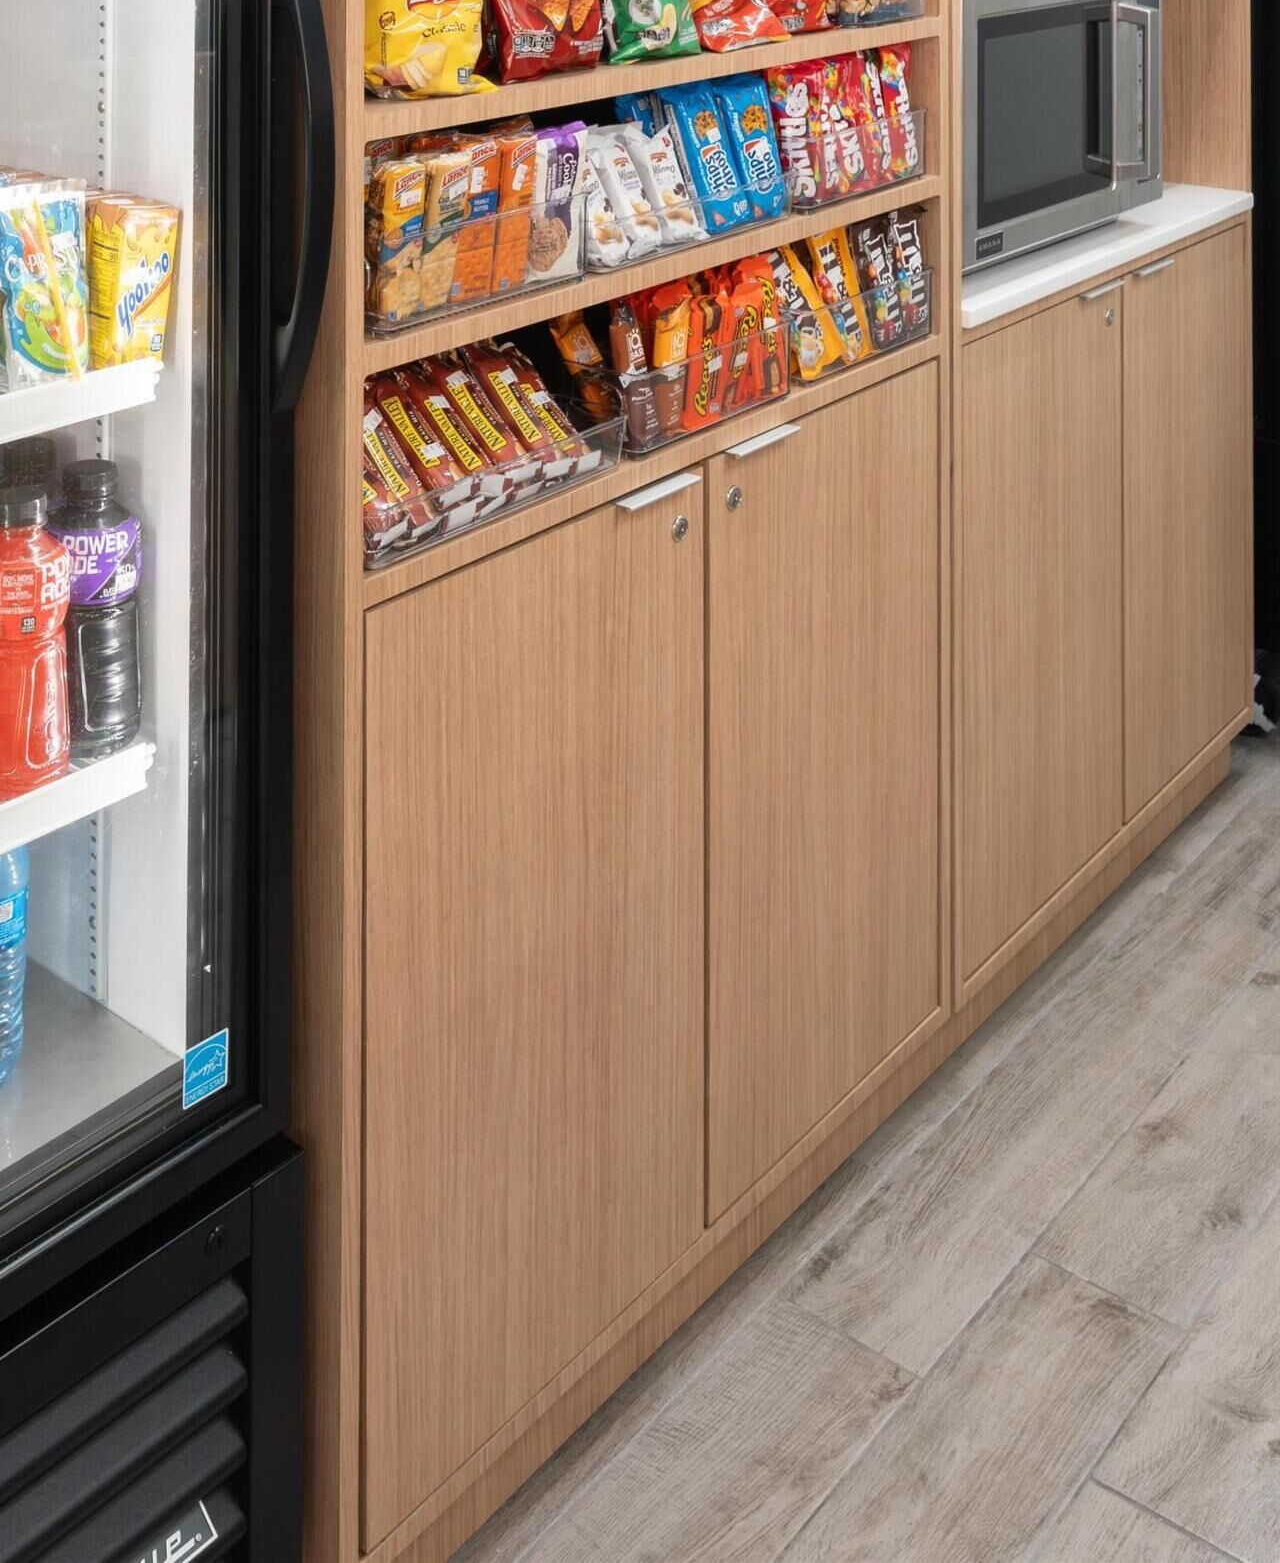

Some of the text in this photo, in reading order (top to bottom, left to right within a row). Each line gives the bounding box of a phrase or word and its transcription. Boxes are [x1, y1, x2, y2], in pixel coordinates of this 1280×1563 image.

[371, 140, 393, 159] ance
[471, 144, 496, 162] ance
[395, 170, 424, 192] Lance
[442, 164, 469, 187] Lance
[474, 198, 490, 206] PEANUT
[474, 204, 489, 212] BUTTER
[630, 348, 645, 360] BAR
[384, 398, 408, 432] VALLEY
[483, 407, 497, 425] TRAIL
[510, 403, 537, 440] NATURE
[417, 424, 433, 444] TRAIL
[471, 411, 501, 448] NATURE
[387, 448, 401, 469] TRAIL
[448, 431, 478, 467] NATURE
[63, 530, 129, 556] POWER
[23, 618, 36, 626] 130
[186, 1076, 225, 1105] ENERGY STAR
